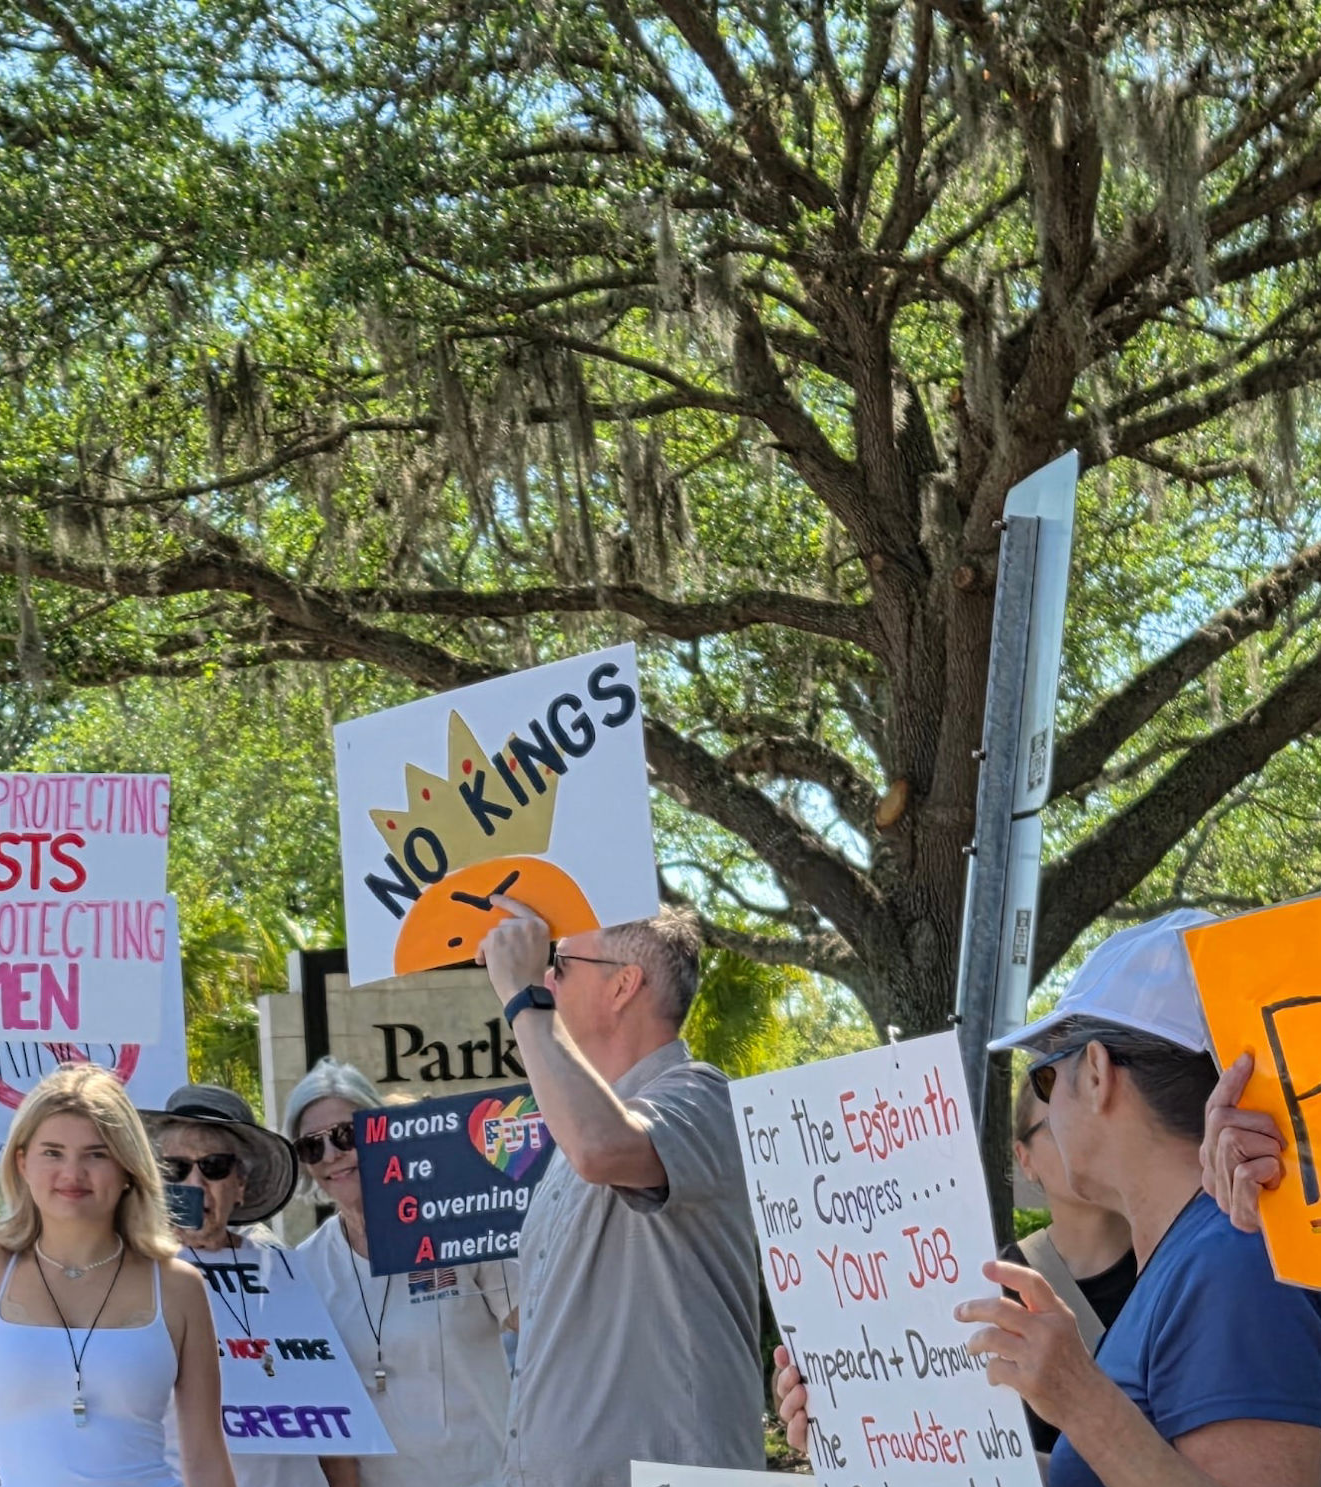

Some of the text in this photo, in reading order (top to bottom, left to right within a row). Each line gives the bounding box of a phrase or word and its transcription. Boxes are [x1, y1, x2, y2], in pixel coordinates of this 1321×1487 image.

[364, 662, 636, 920] NO KINGS
[365, 1111, 543, 1155] Morons FDT
[743, 1105, 780, 1165] For
[790, 1099, 840, 1165] the
[383, 1155, 433, 1184] Are
[398, 1186, 529, 1224] Governing
[756, 1180, 801, 1238] time
[415, 1229, 519, 1265] America
[274, 1338, 336, 1360] MAKE
[781, 1324, 889, 1408] Impeach
[221, 1405, 352, 1438] GREAT
[861, 1411, 967, 1469] Fraudster
[978, 1409, 1022, 1460] who
